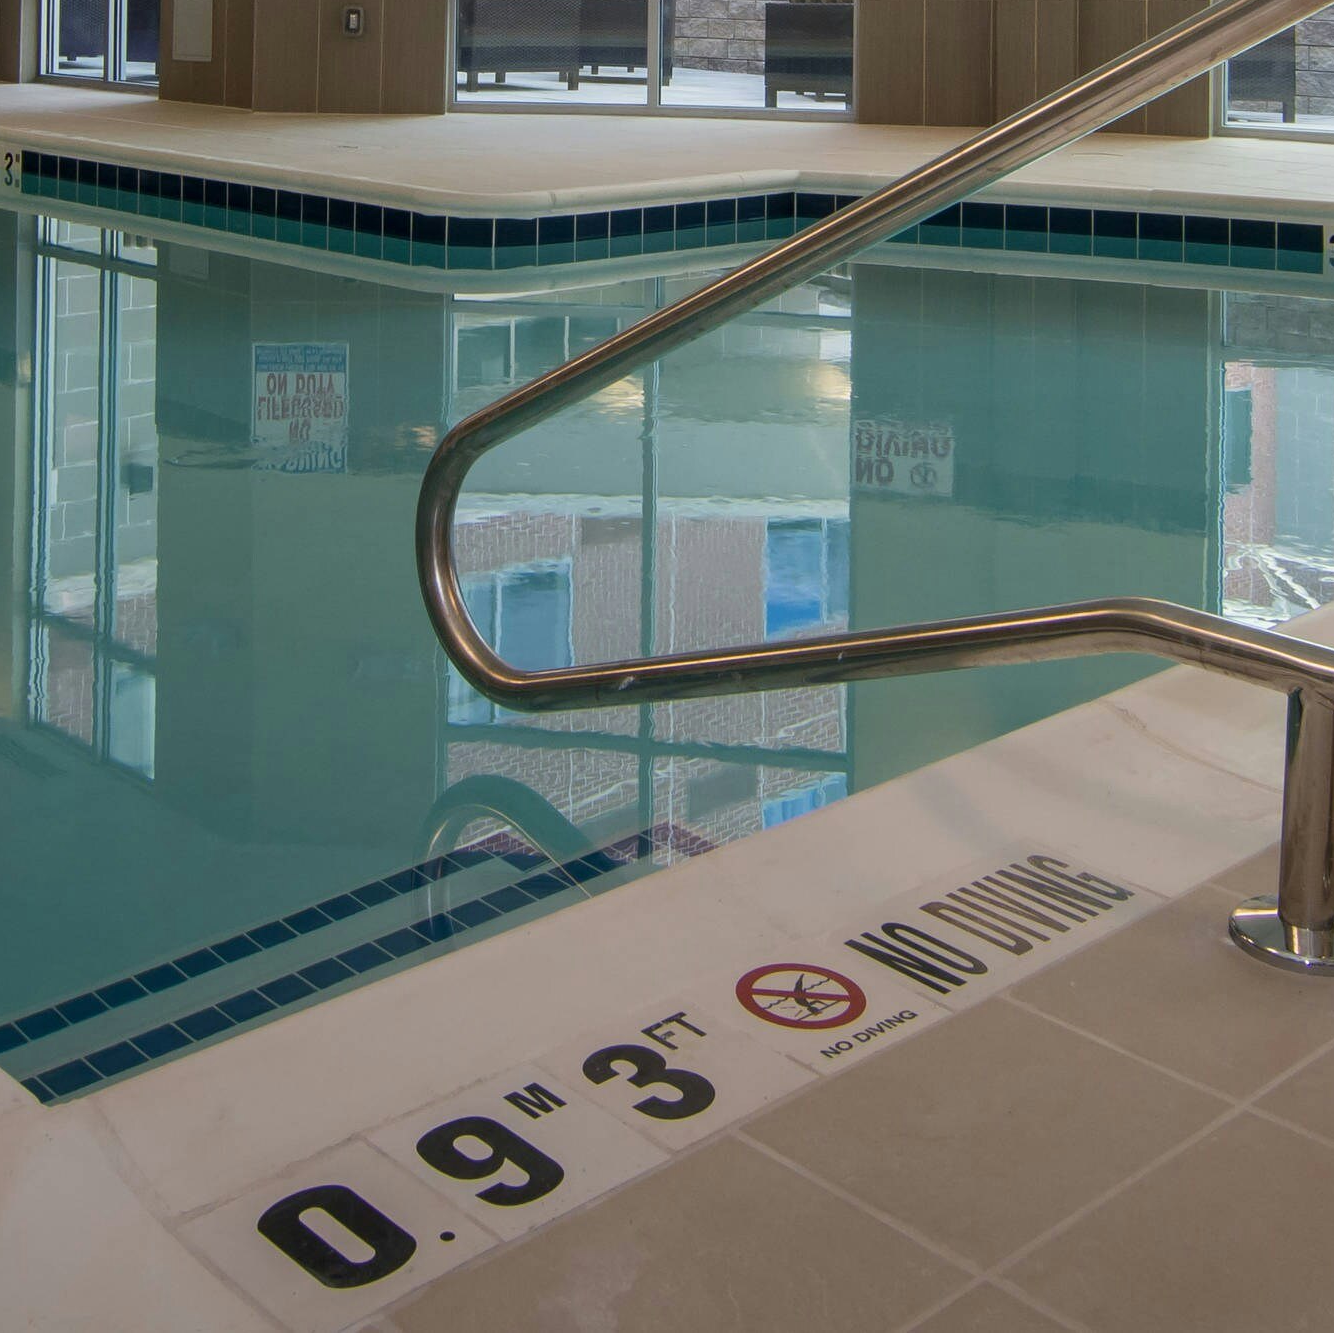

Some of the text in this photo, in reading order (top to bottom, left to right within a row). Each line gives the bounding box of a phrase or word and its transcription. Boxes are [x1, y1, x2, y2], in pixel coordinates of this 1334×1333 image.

[843, 854, 1136, 995] NO DIVING
[581, 1011, 716, 1121] 3 FT
[819, 1009, 919, 1059] NO DIVING
[256, 1082, 568, 1289] 0.9 M
